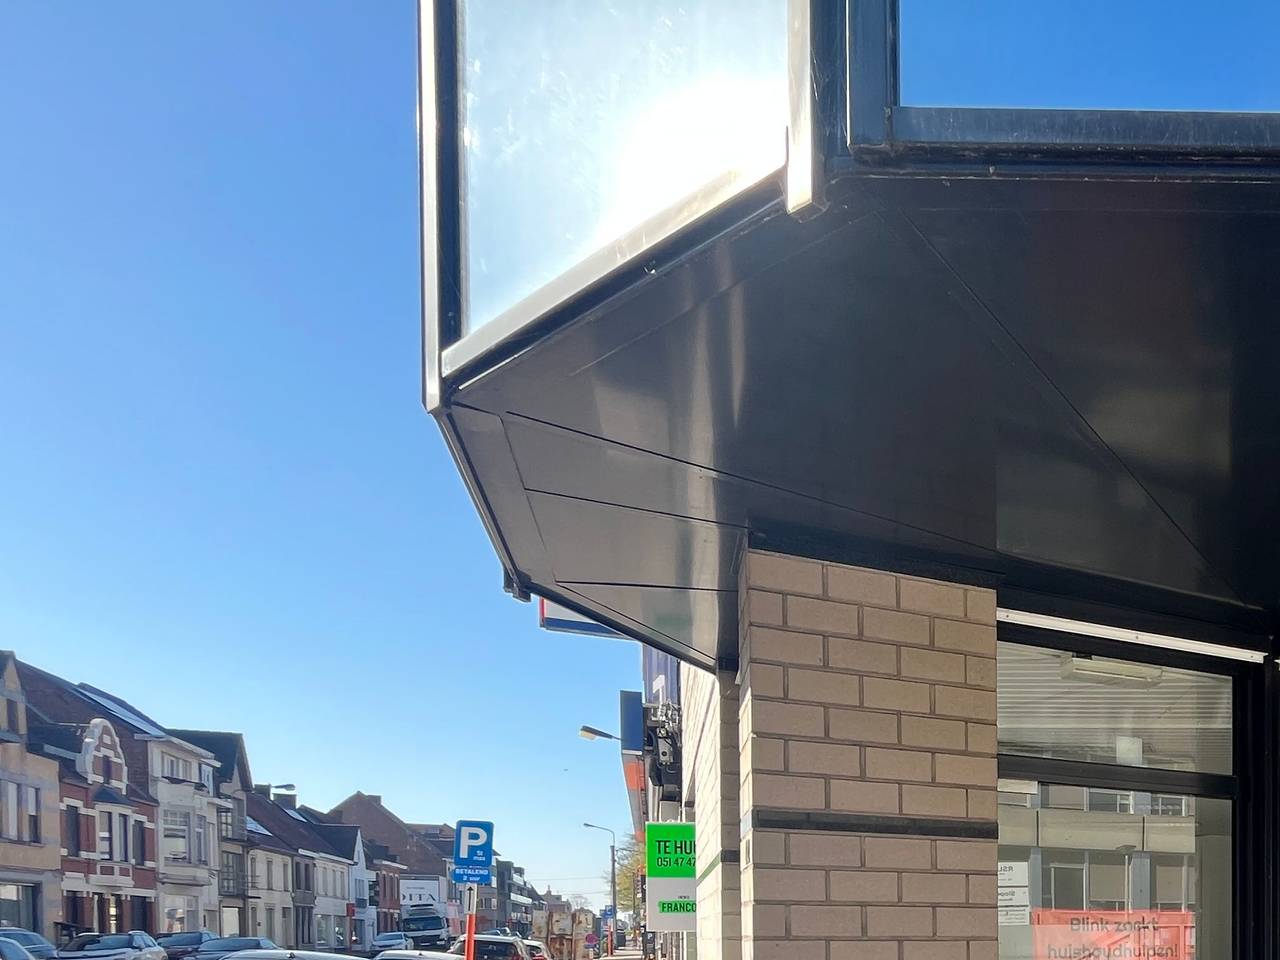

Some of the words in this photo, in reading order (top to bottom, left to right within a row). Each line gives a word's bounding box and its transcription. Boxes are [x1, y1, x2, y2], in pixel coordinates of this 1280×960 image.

[460, 827, 488, 858] P
[656, 840, 671, 855] TE
[674, 840, 696, 855] HU
[656, 857, 672, 867] 051
[673, 857, 684, 867] 47
[1070, 917, 1109, 932] Blink
